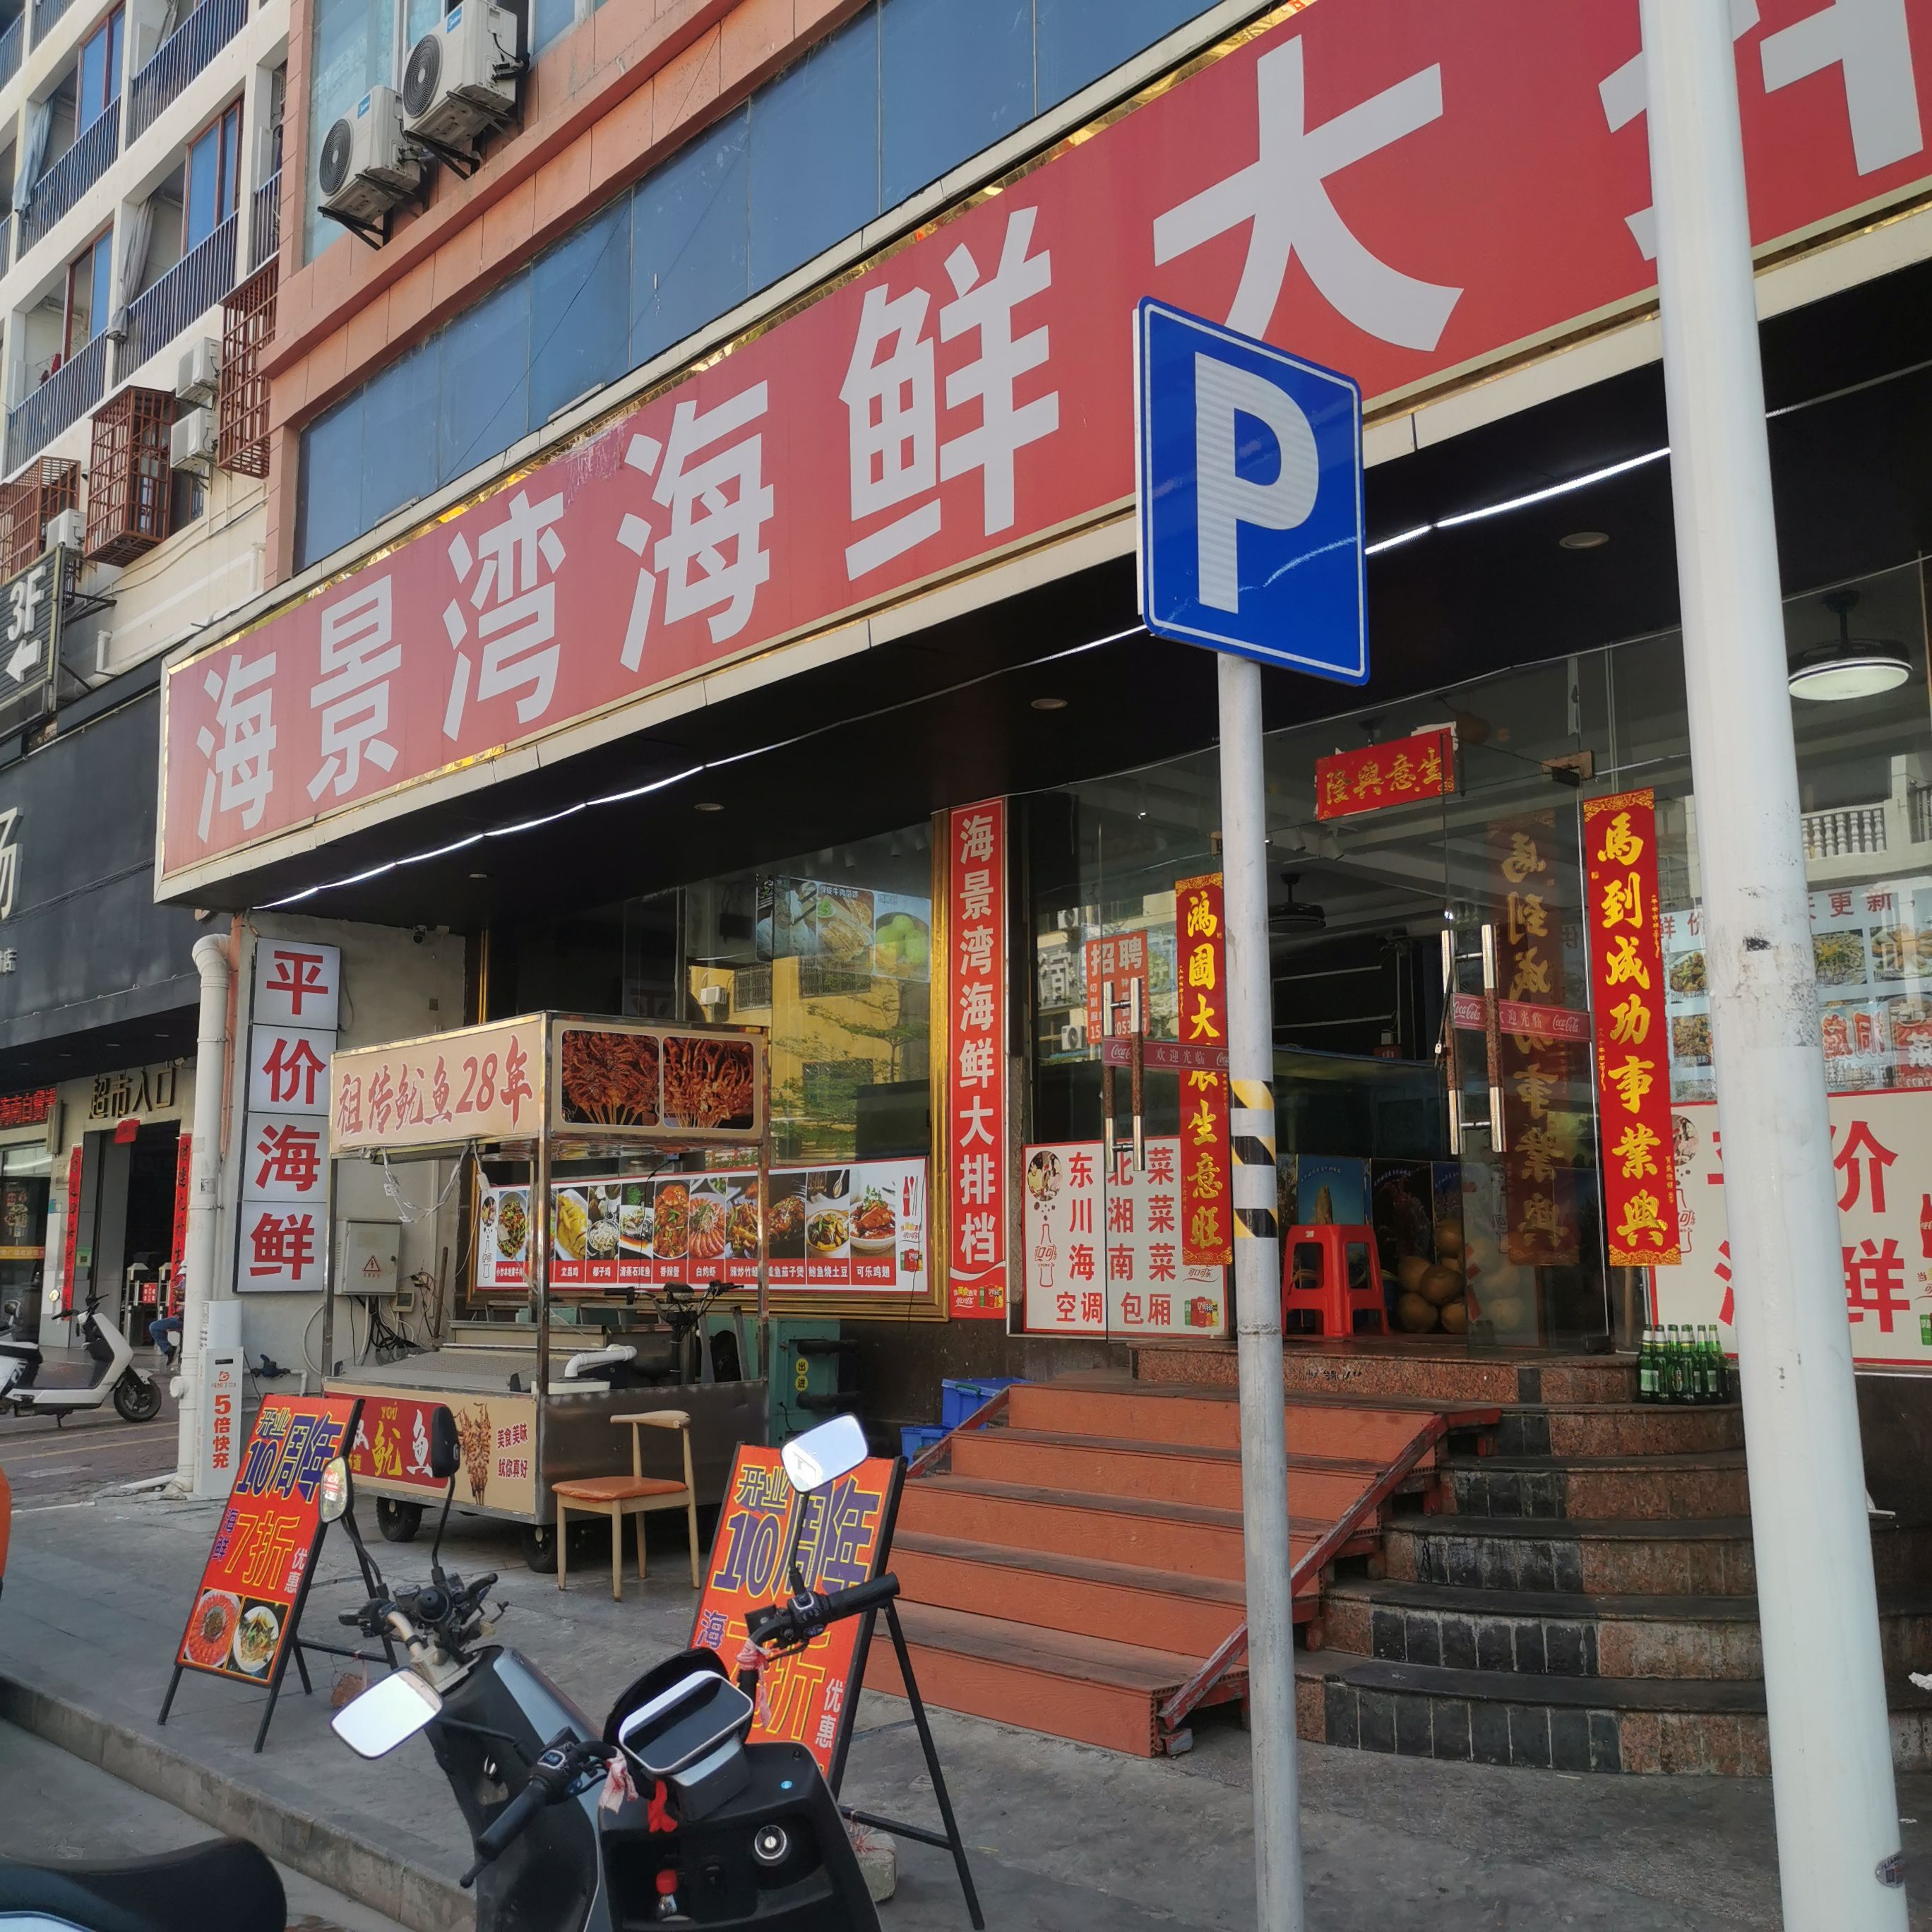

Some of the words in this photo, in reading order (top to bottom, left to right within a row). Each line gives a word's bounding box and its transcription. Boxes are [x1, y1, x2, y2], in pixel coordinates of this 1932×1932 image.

[197, 0, 1924, 844] 海景湾海鲜大
[1194, 351, 1320, 614] P
[8, 566, 47, 642] 3F
[1090, 936, 1143, 977] 招聘
[960, 815, 996, 1264] 海景湾海鲜大排档
[1156, 1048, 1205, 1065] 欢迎光临
[90, 1066, 177, 1119] 超市入口
[337, 1035, 532, 1136] 祖传鱿鱼28年
[249, 950, 328, 1280] 平价海鲜
[1068, 1147, 1174, 1188] 东北菜
[1069, 1194, 1176, 1234] 川湘菜
[561, 1267, 578, 1277] 文昌鸡
[592, 1266, 611, 1277] 椰子鸡
[619, 1266, 650, 1277] 清蒸石斑鱼
[660, 1266, 680, 1277] 香辣蟹
[696, 1266, 717, 1277] 白灼虾
[809, 1266, 848, 1277] 鲍鱼烧土豆
[857, 1266, 890, 1278] 可乐鸡翅
[1068, 1243, 1176, 1282] 海南菜
[1056, 1292, 1171, 1325] 空调包厢
[213, 1394, 232, 1469] 5倍快充
[256, 1407, 290, 1436] 开业
[497, 1422, 528, 1449] 美食美味
[234, 1411, 346, 1504] 10周年
[735, 1463, 789, 1510] 开业
[225, 1510, 301, 1590] 7折
[711, 1474, 883, 1603] 10周年
[284, 1547, 308, 1594] 优惠
[815, 1678, 844, 1748] 优惠
